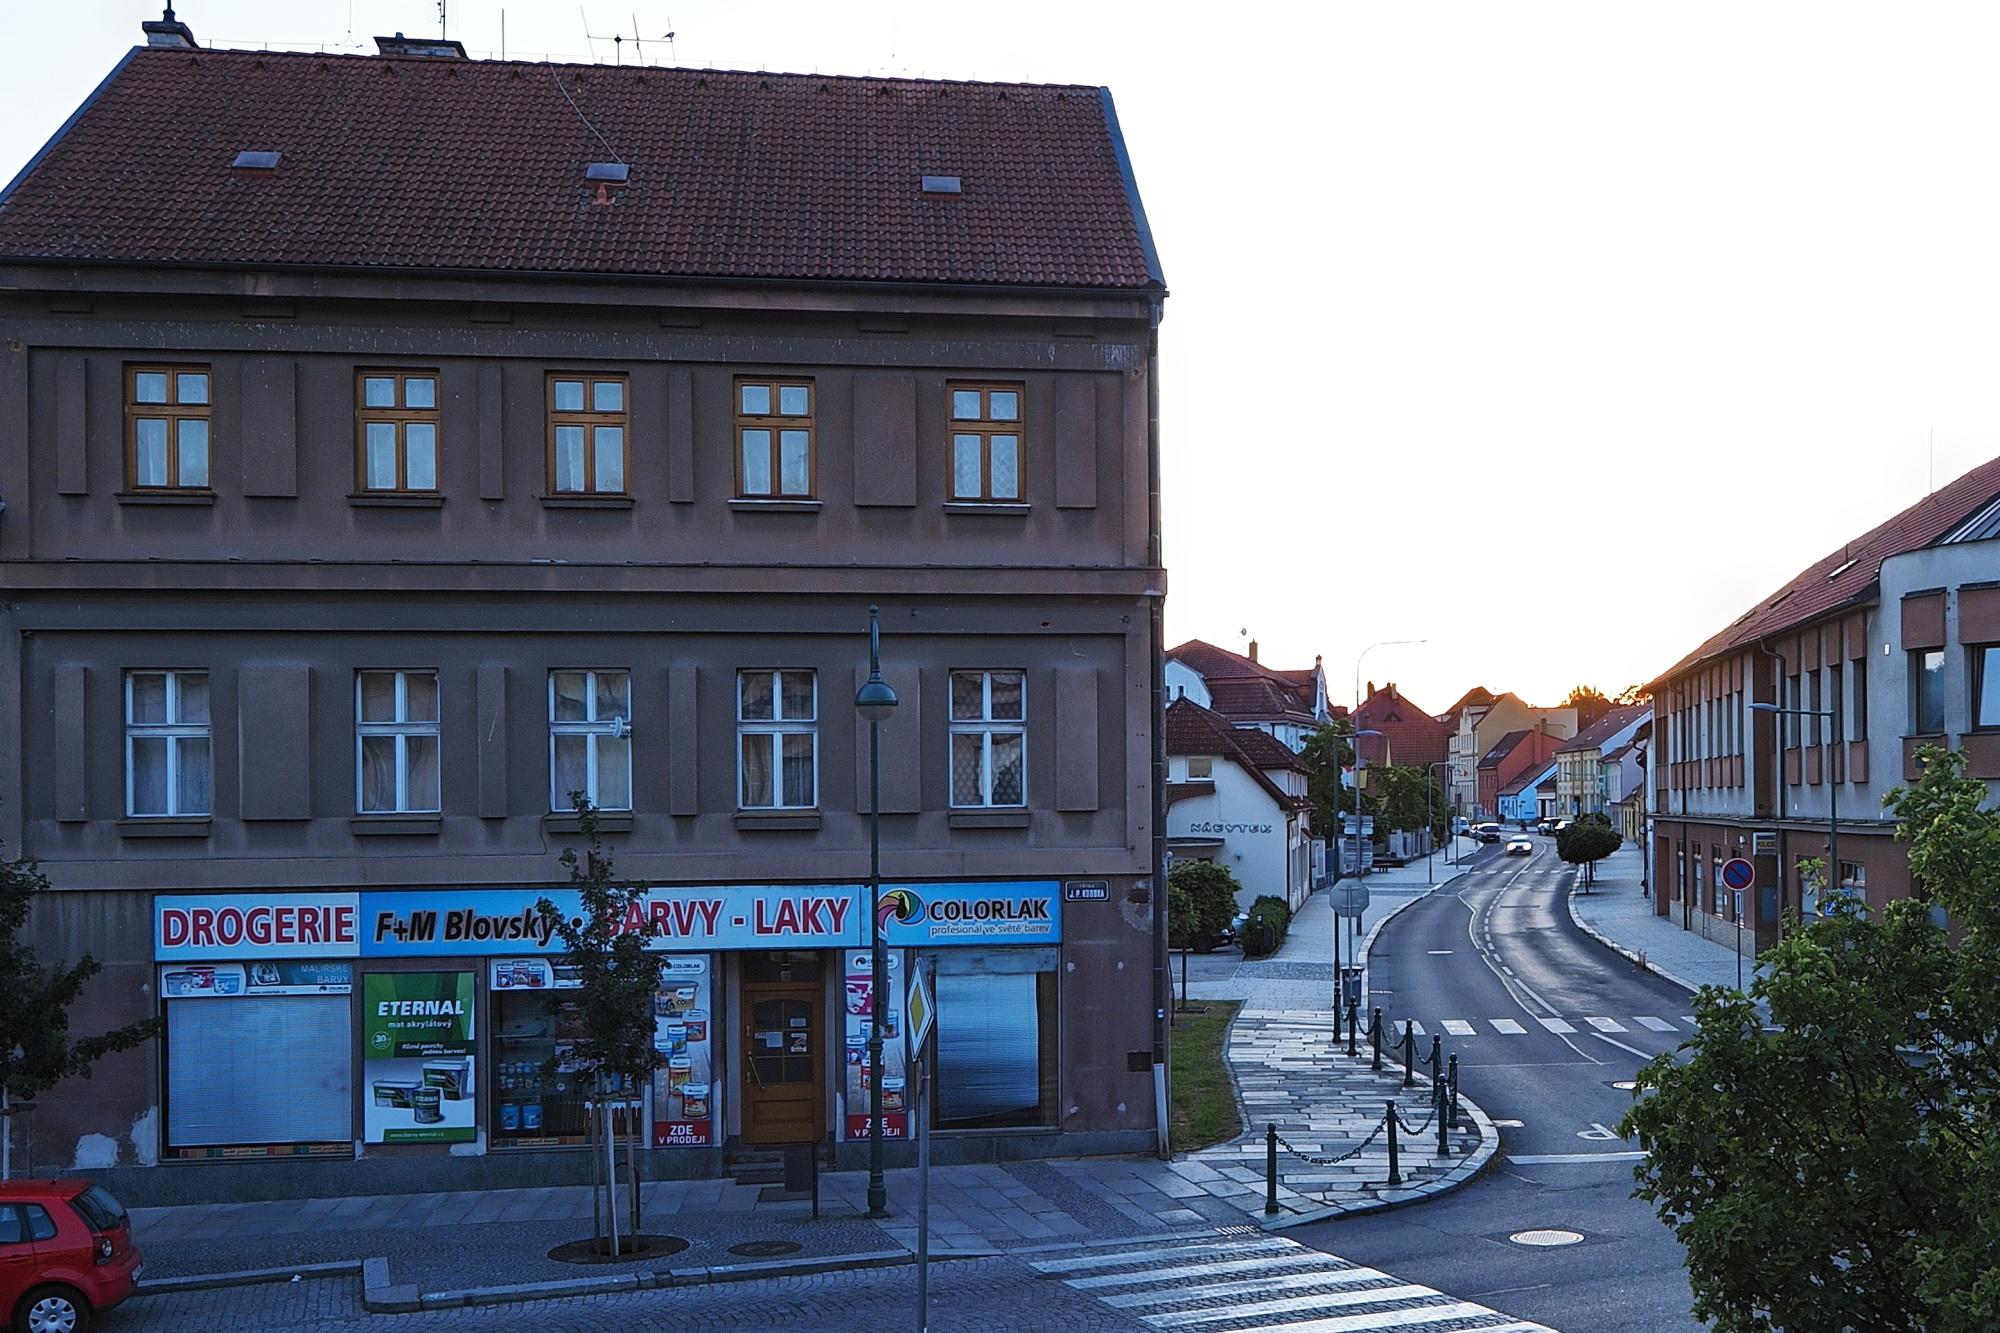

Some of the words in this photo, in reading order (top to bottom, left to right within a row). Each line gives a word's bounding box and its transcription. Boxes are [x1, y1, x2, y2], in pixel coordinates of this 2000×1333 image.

[929, 899, 1050, 921] COLORLAK
[755, 898, 850, 936] LAKY
[162, 905, 355, 947] DROGERIE
[375, 911, 436, 942] F+M
[931, 923, 982, 938] profesionál
[985, 926, 995, 934] ve
[1024, 922, 1050, 934] barev
[317, 975, 348, 984] BARVY
[378, 1000, 465, 1016] ETERNAL
[406, 1018, 453, 1029] akrylátový
[865, 1117, 889, 1128] ZE
[670, 1124, 694, 1135] ZDE
[854, 1129, 860, 1137] V
[659, 1136, 665, 1144] V
[667, 1135, 706, 1144] PRODEJI
